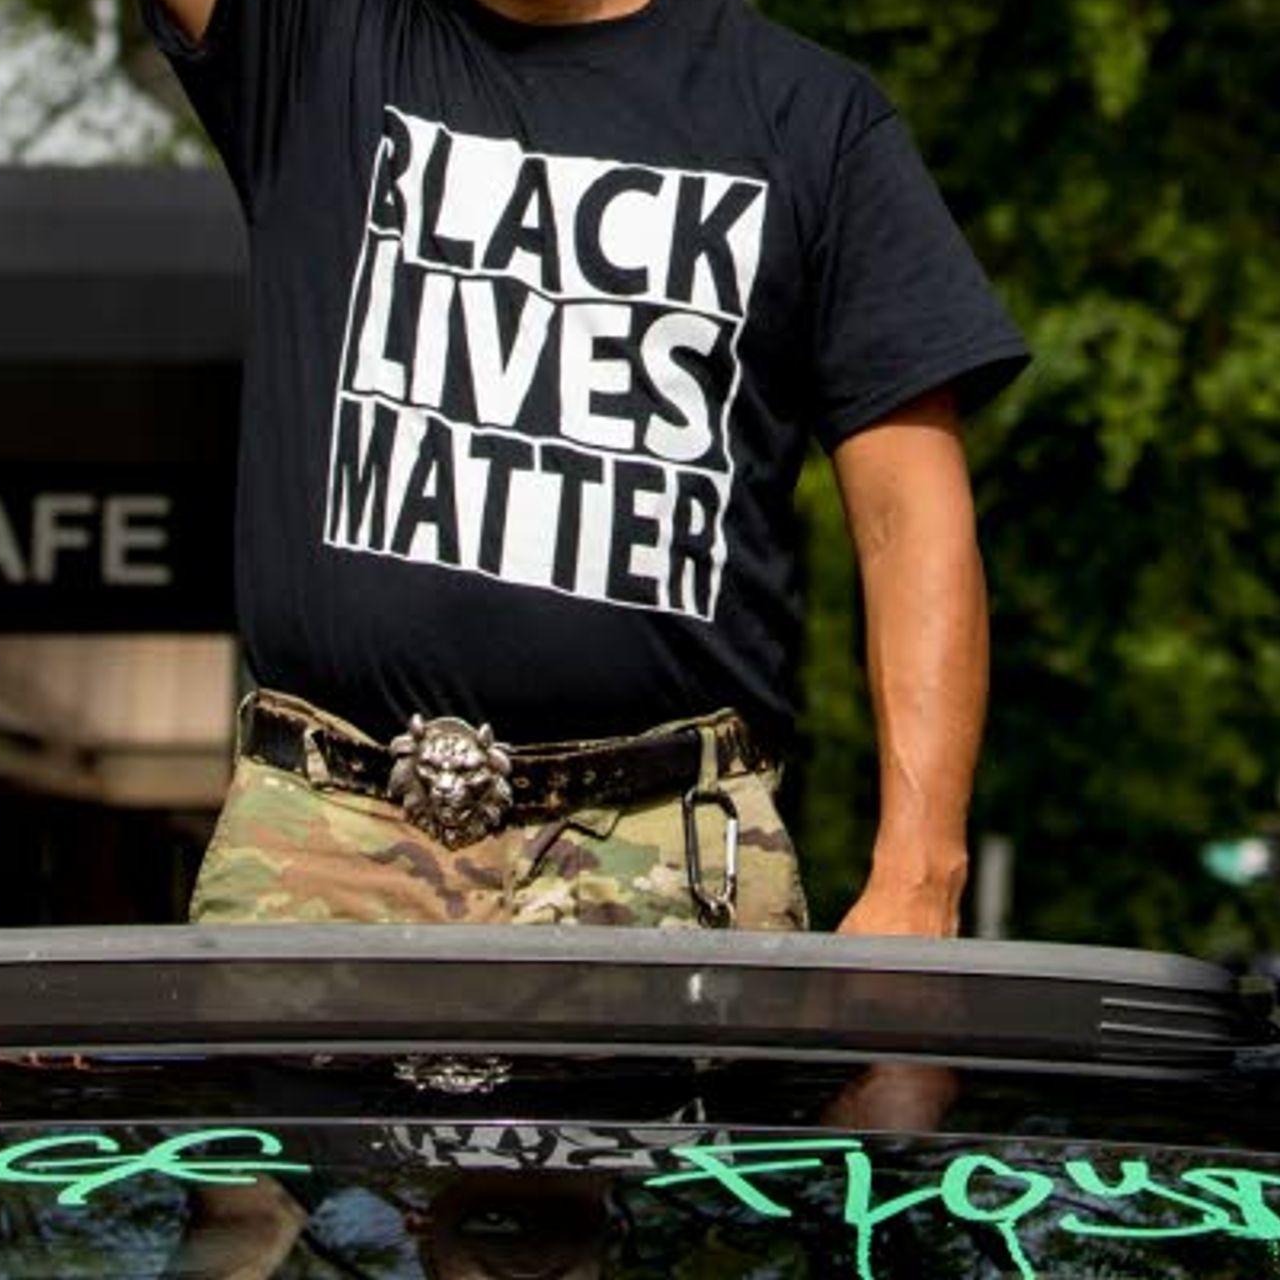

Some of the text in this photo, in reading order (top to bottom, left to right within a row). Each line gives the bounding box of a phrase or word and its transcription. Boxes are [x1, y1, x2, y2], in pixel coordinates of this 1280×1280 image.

[370, 118, 765, 318] BLACK
[352, 237, 722, 463] LIVES
[329, 400, 721, 617] MATTER
